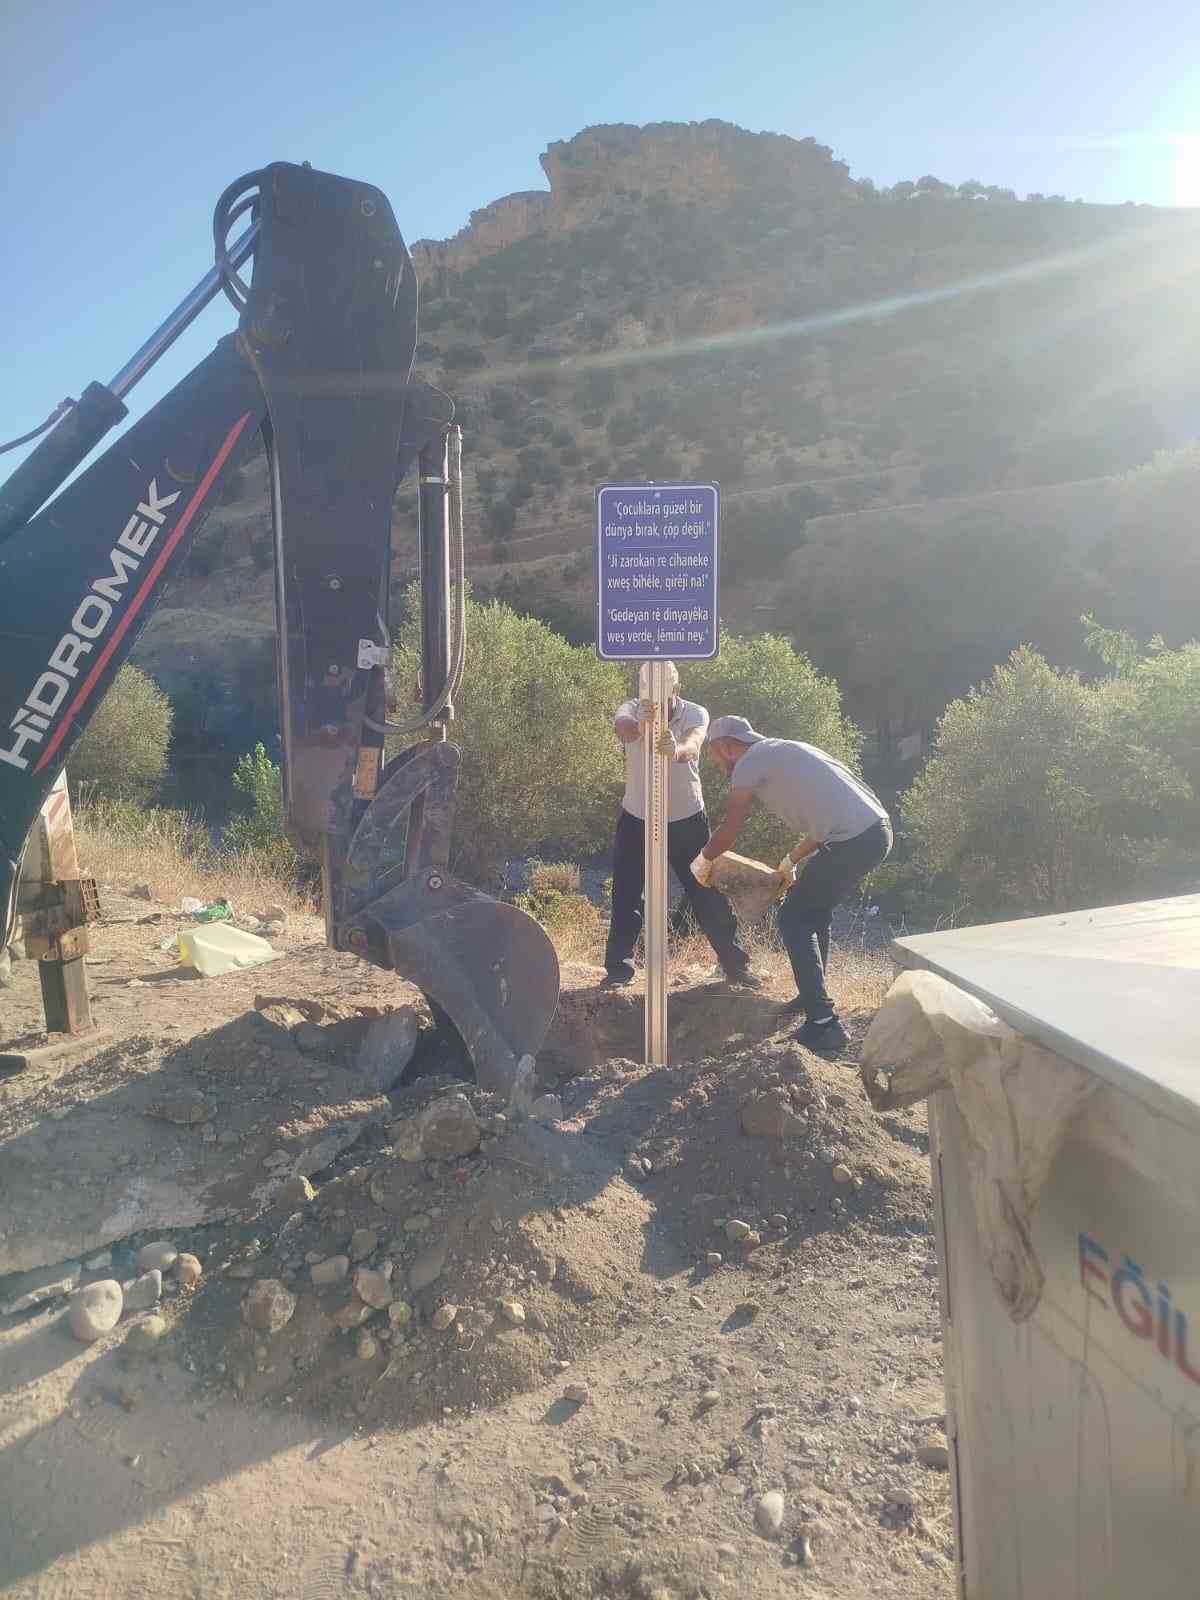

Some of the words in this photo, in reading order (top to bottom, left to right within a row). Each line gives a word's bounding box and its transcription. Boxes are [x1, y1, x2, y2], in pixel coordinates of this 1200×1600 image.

[690, 499, 702, 514] bir
[605, 521, 633, 539] dünya
[663, 521, 680, 539] çöp
[620, 553, 655, 568] zarokan
[607, 576, 631, 592] xweş
[0, 476, 182, 769] HİDROMEK
[607, 630, 625, 645] weş
